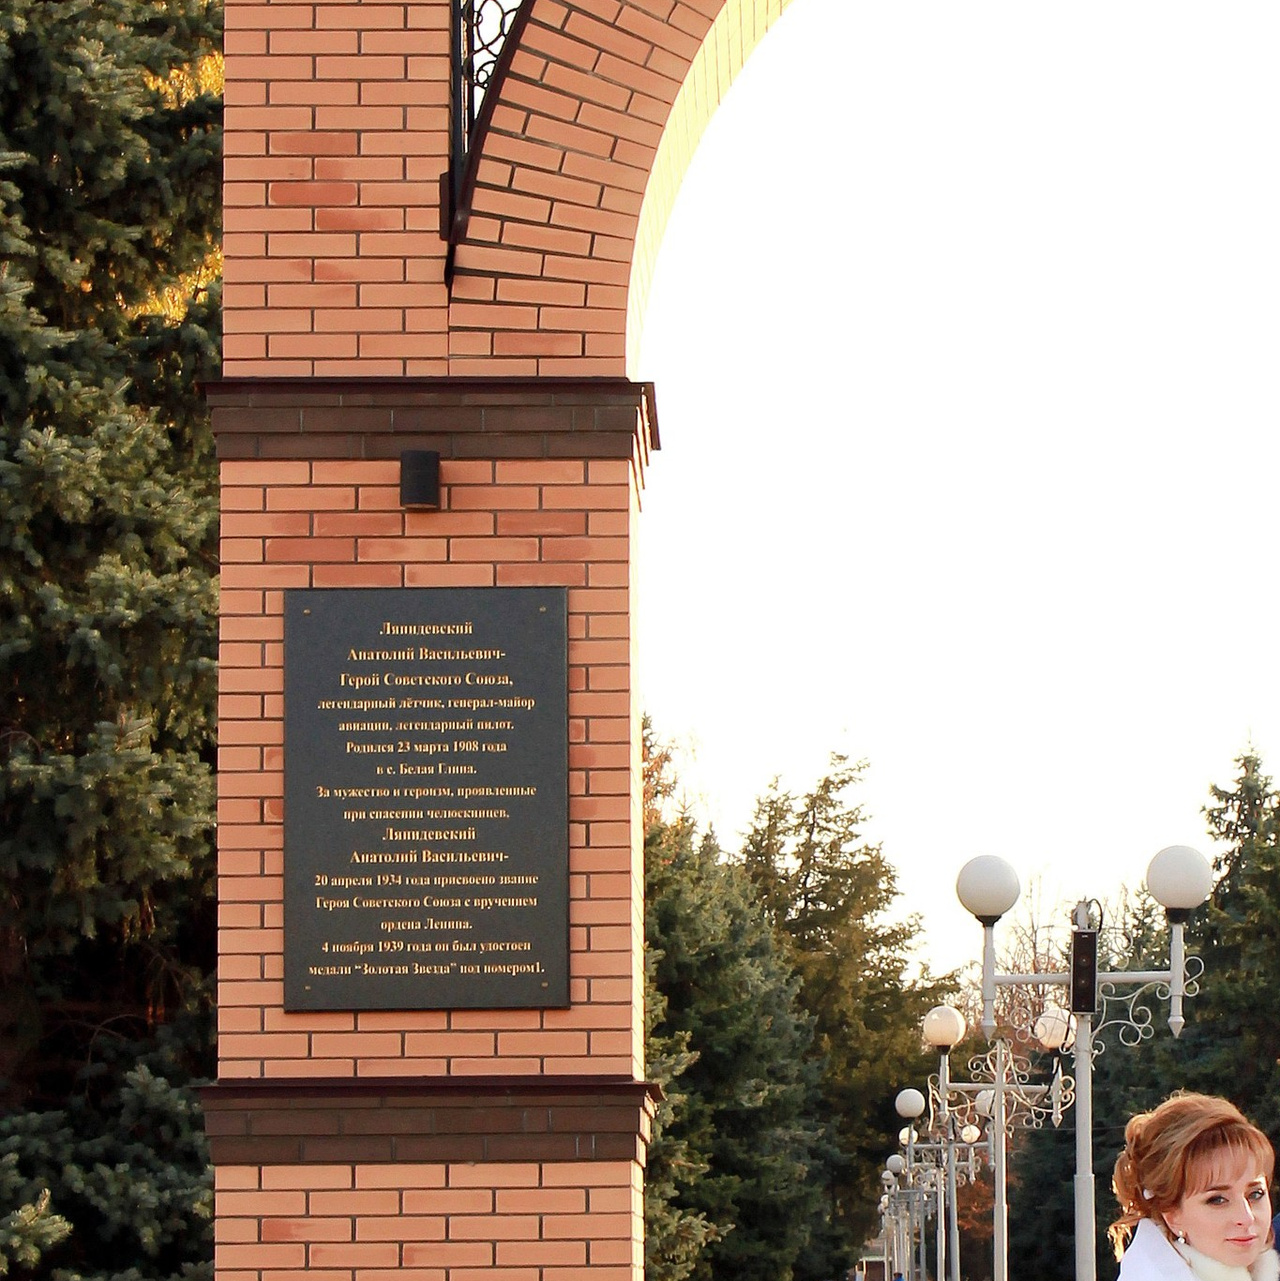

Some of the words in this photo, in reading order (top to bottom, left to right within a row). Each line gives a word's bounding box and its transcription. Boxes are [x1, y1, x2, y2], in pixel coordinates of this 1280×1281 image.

[379, 622, 473, 635] Ляпидевский
[346, 648, 415, 660] Анатолий
[340, 673, 380, 689] Герой
[383, 673, 462, 685] Советского
[317, 698, 396, 711] легендарный
[447, 697, 536, 710] генерал-майор
[394, 719, 474, 733] легендарный
[346, 742, 395, 754] Родился
[397, 741, 411, 752] 23
[413, 744, 450, 755] марта
[453, 740, 479, 752] 1908
[481, 743, 507, 752] года
[399, 763, 435, 774] Белая
[315, 786, 331, 797] За
[333, 788, 391, 800] мужество
[457, 787, 537, 799] проявленные
[343, 810, 368, 822] при
[369, 810, 424, 819] спасении
[381, 827, 476, 841] Ляпидевский
[349, 850, 418, 863] Анатолий
[314, 875, 329, 886] 20
[330, 877, 373, 888] апреля
[376, 874, 402, 885] 1934
[405, 877, 431, 886] года
[433, 876, 496, 888] присвоено
[498, 876, 539, 884] звание
[315, 897, 350, 911] Героя
[352, 897, 421, 908] Советского
[422, 896, 462, 907] Союза
[463, 899, 471, 907] с
[473, 897, 538, 909] вручением
[380, 921, 422, 933] ордена
[321, 942, 329, 952] 4
[331, 941, 374, 955] ноября
[378, 941, 404, 952] 1939
[406, 943, 432, 952] года
[434, 943, 450, 951] он
[451, 940, 477, 951] был
[477, 942, 531, 954] удостоен
[308, 966, 352, 975] медали
[459, 965, 481, 974] под
